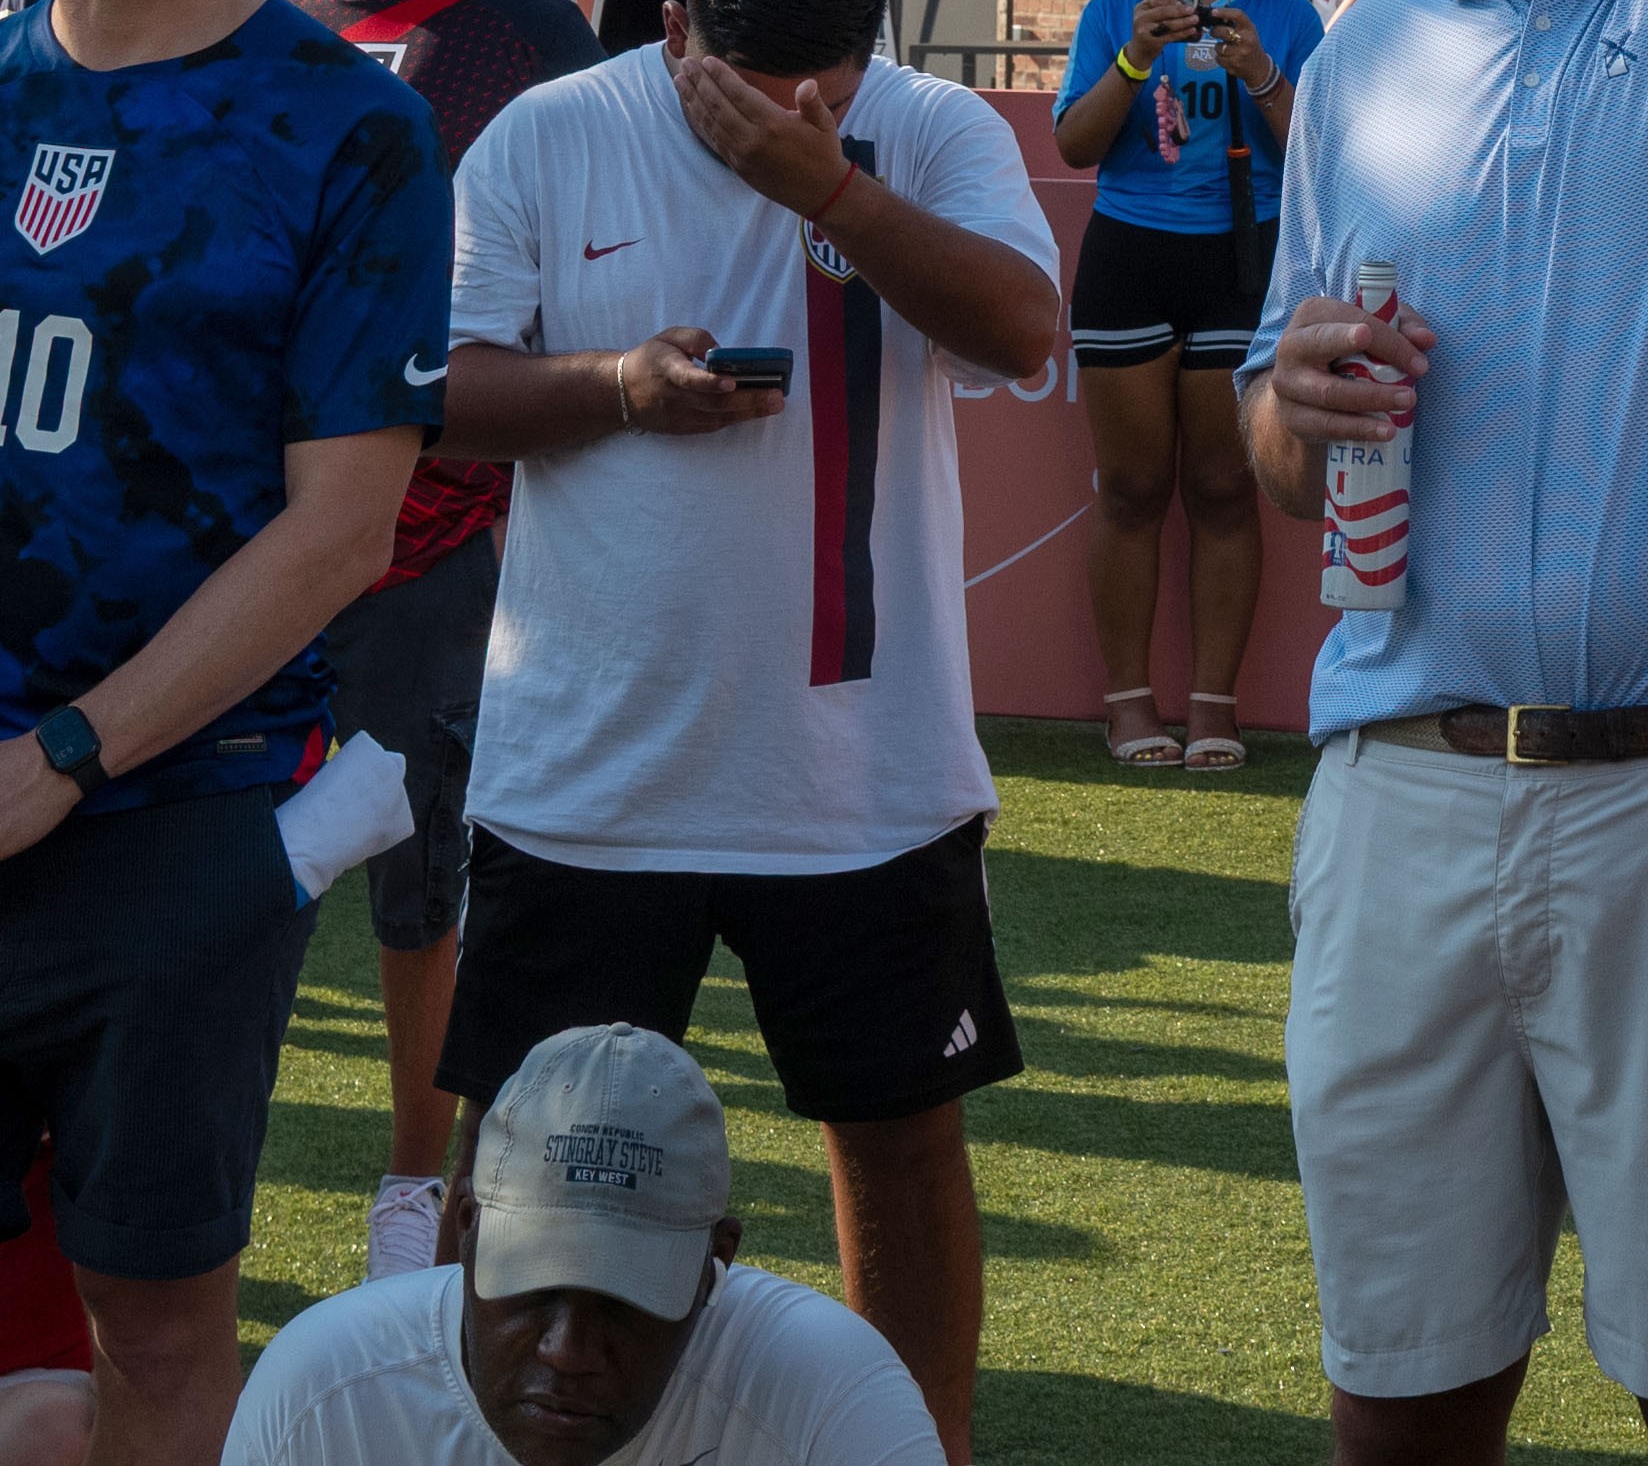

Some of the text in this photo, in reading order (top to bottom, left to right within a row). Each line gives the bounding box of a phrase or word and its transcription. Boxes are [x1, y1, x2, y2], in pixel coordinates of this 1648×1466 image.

[1181, 81, 1224, 120] 10
[34, 147, 106, 196] USA
[1329, 443, 1384, 465] LTRA
[570, 1124, 644, 1141] CONCH REPUBLIC
[544, 1134, 664, 1176] STINGRAY STEVE
[575, 1169, 629, 1185] KEY WEST
